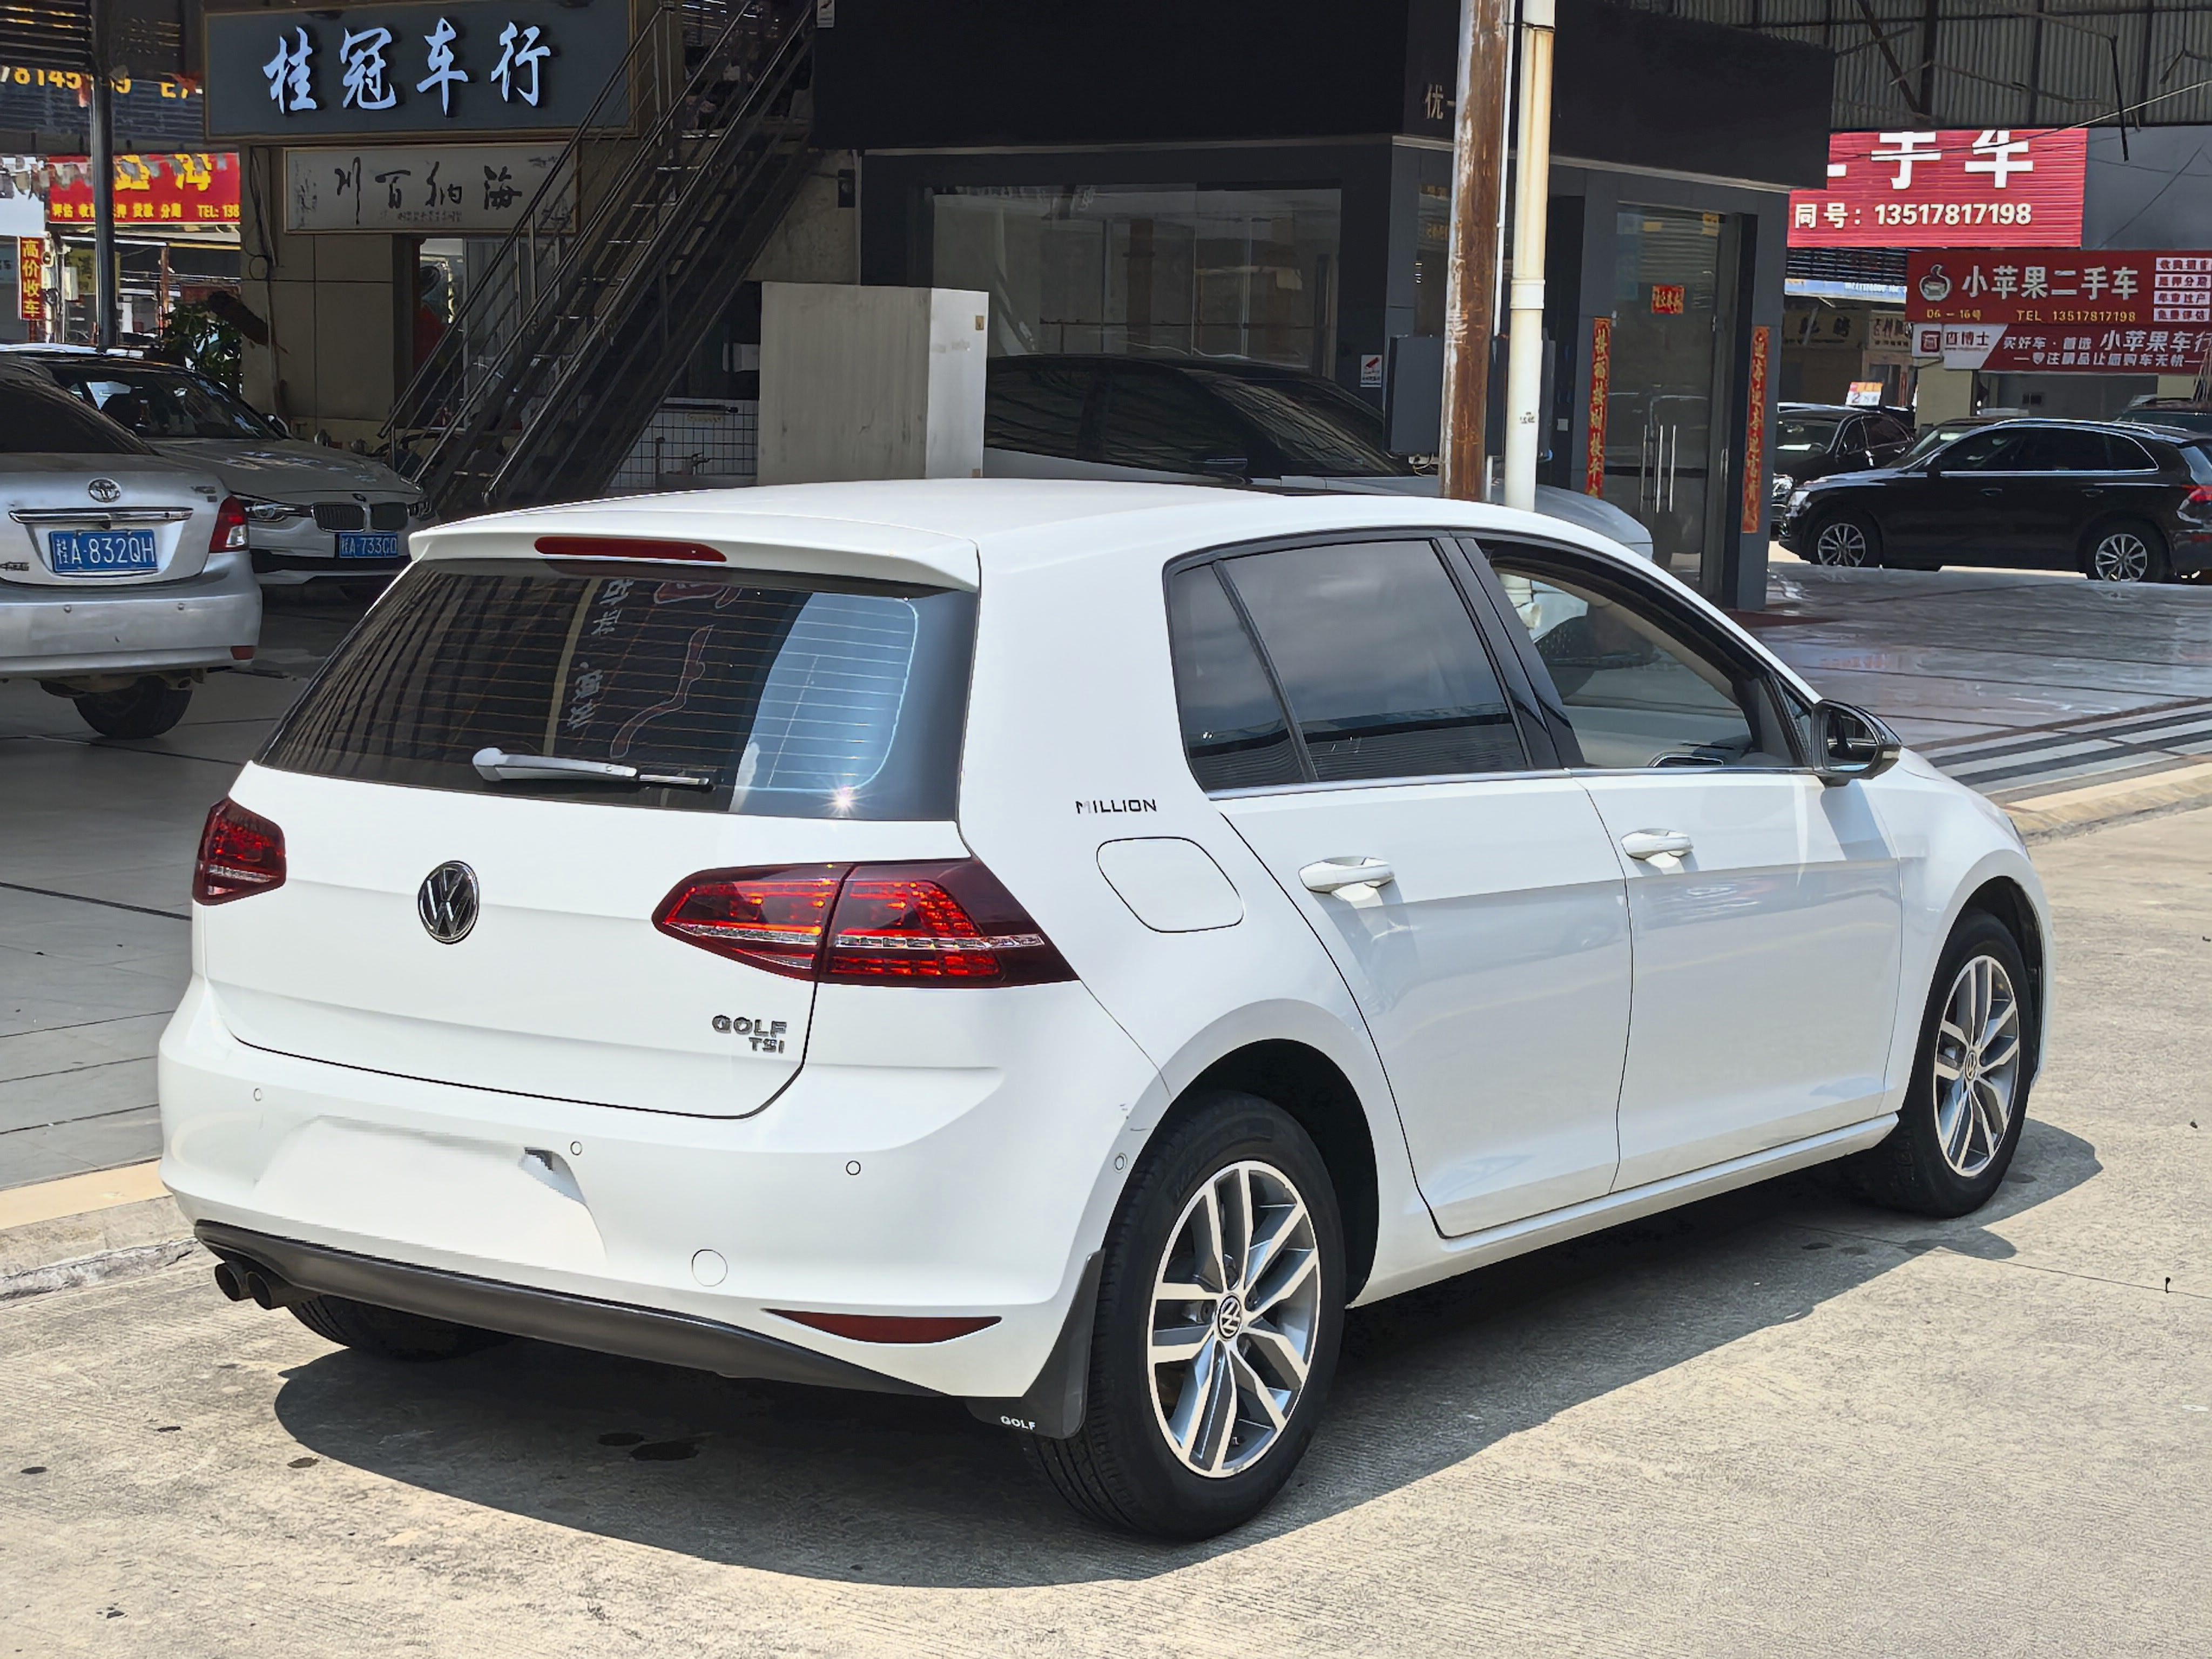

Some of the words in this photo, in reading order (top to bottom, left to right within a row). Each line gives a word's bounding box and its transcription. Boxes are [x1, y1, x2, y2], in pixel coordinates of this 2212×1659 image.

[262, 17, 550, 116] 桂冠车行
[1827, 130, 2034, 190] 手车
[1874, 203, 2032, 225] 13517817198
[23, 239, 40, 318] 高价收车
[1961, 265, 2139, 300] 小苹果二手车
[2016, 310, 2042, 322] TEL
[2053, 310, 2136, 322] 13517817198
[1075, 799, 1157, 814] MILLION
[712, 1014, 787, 1038] GOLF
[748, 1036, 785, 1054] TSI
[1000, 1415, 1036, 1431] GOLF
